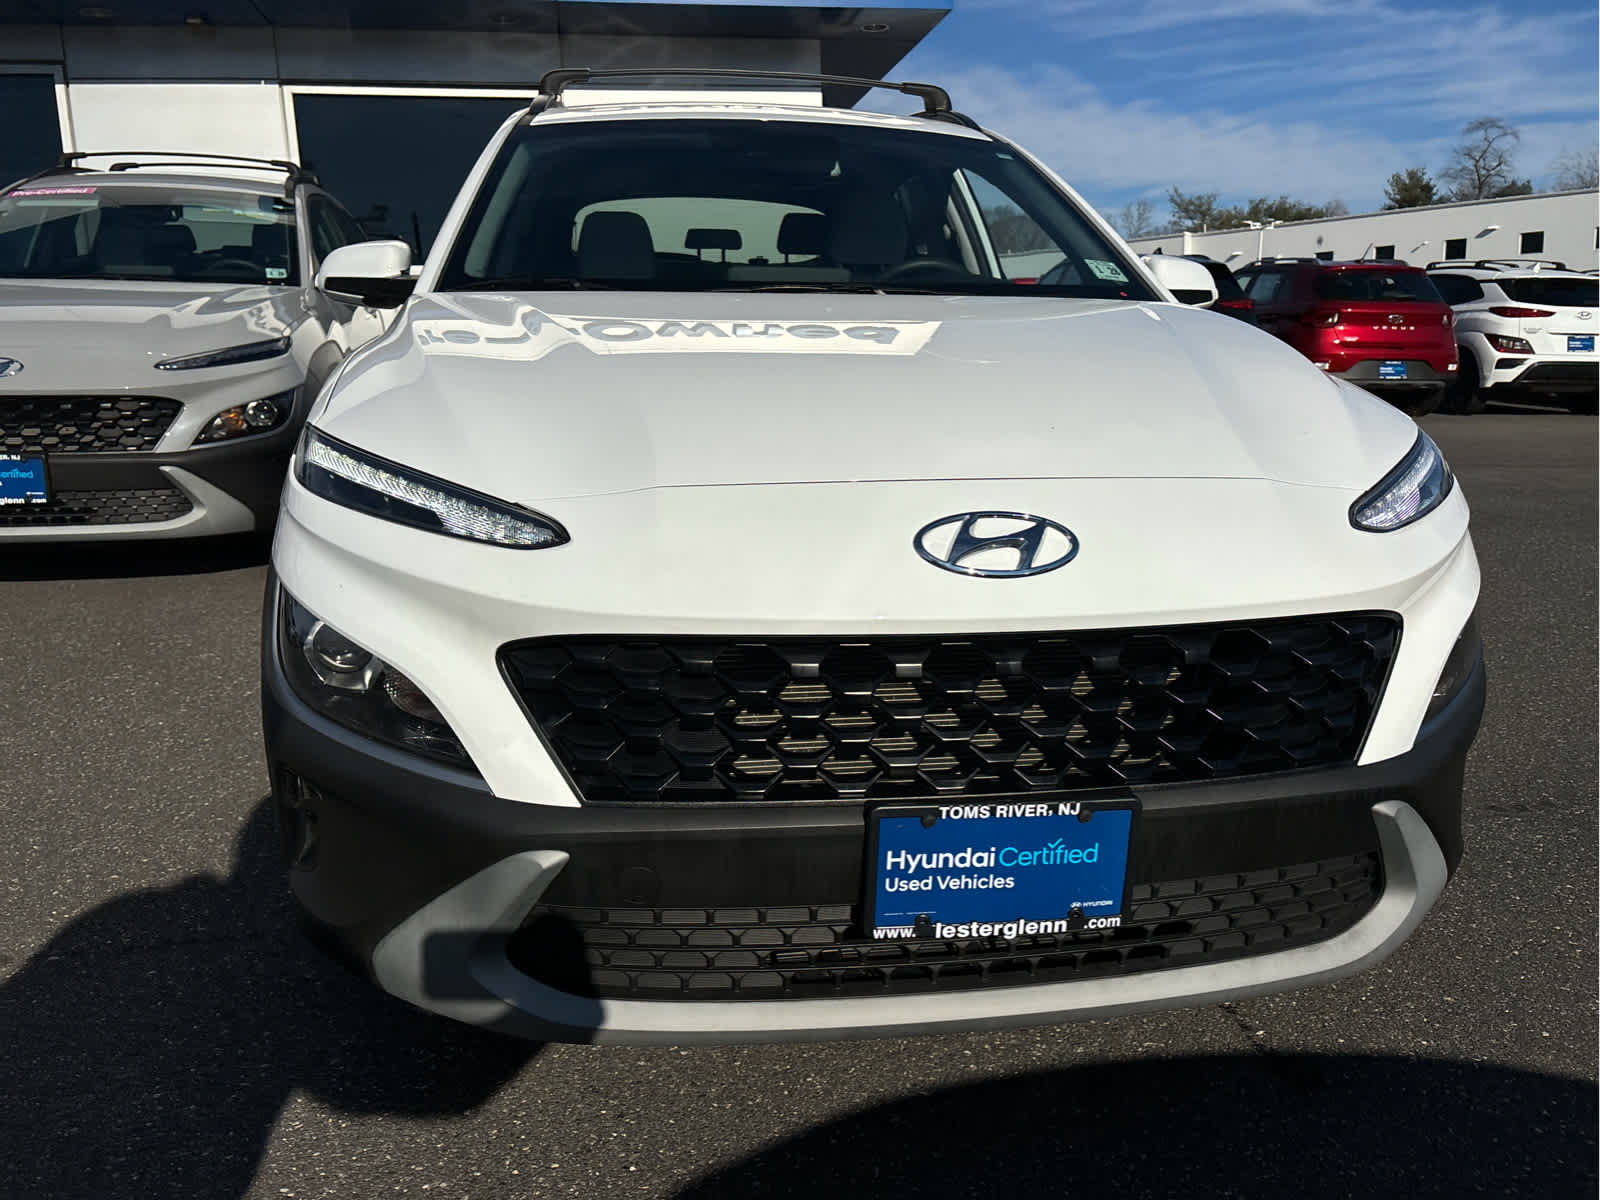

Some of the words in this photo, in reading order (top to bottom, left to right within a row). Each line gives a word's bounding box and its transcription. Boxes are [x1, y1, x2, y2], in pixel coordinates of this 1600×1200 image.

[0, 468, 34, 479] ertified
[938, 805, 991, 820] TOMS
[995, 803, 1054, 818] RIVER,
[1058, 802, 1081, 816] NJ
[886, 846, 996, 874] Hyundai
[1000, 838, 1099, 867] Certified
[885, 875, 933, 893] Used
[936, 874, 1015, 891] Vehicles
[873, 926, 917, 940] www.
[935, 918, 1068, 940] lesterglenn
[1083, 915, 1121, 929] .com
